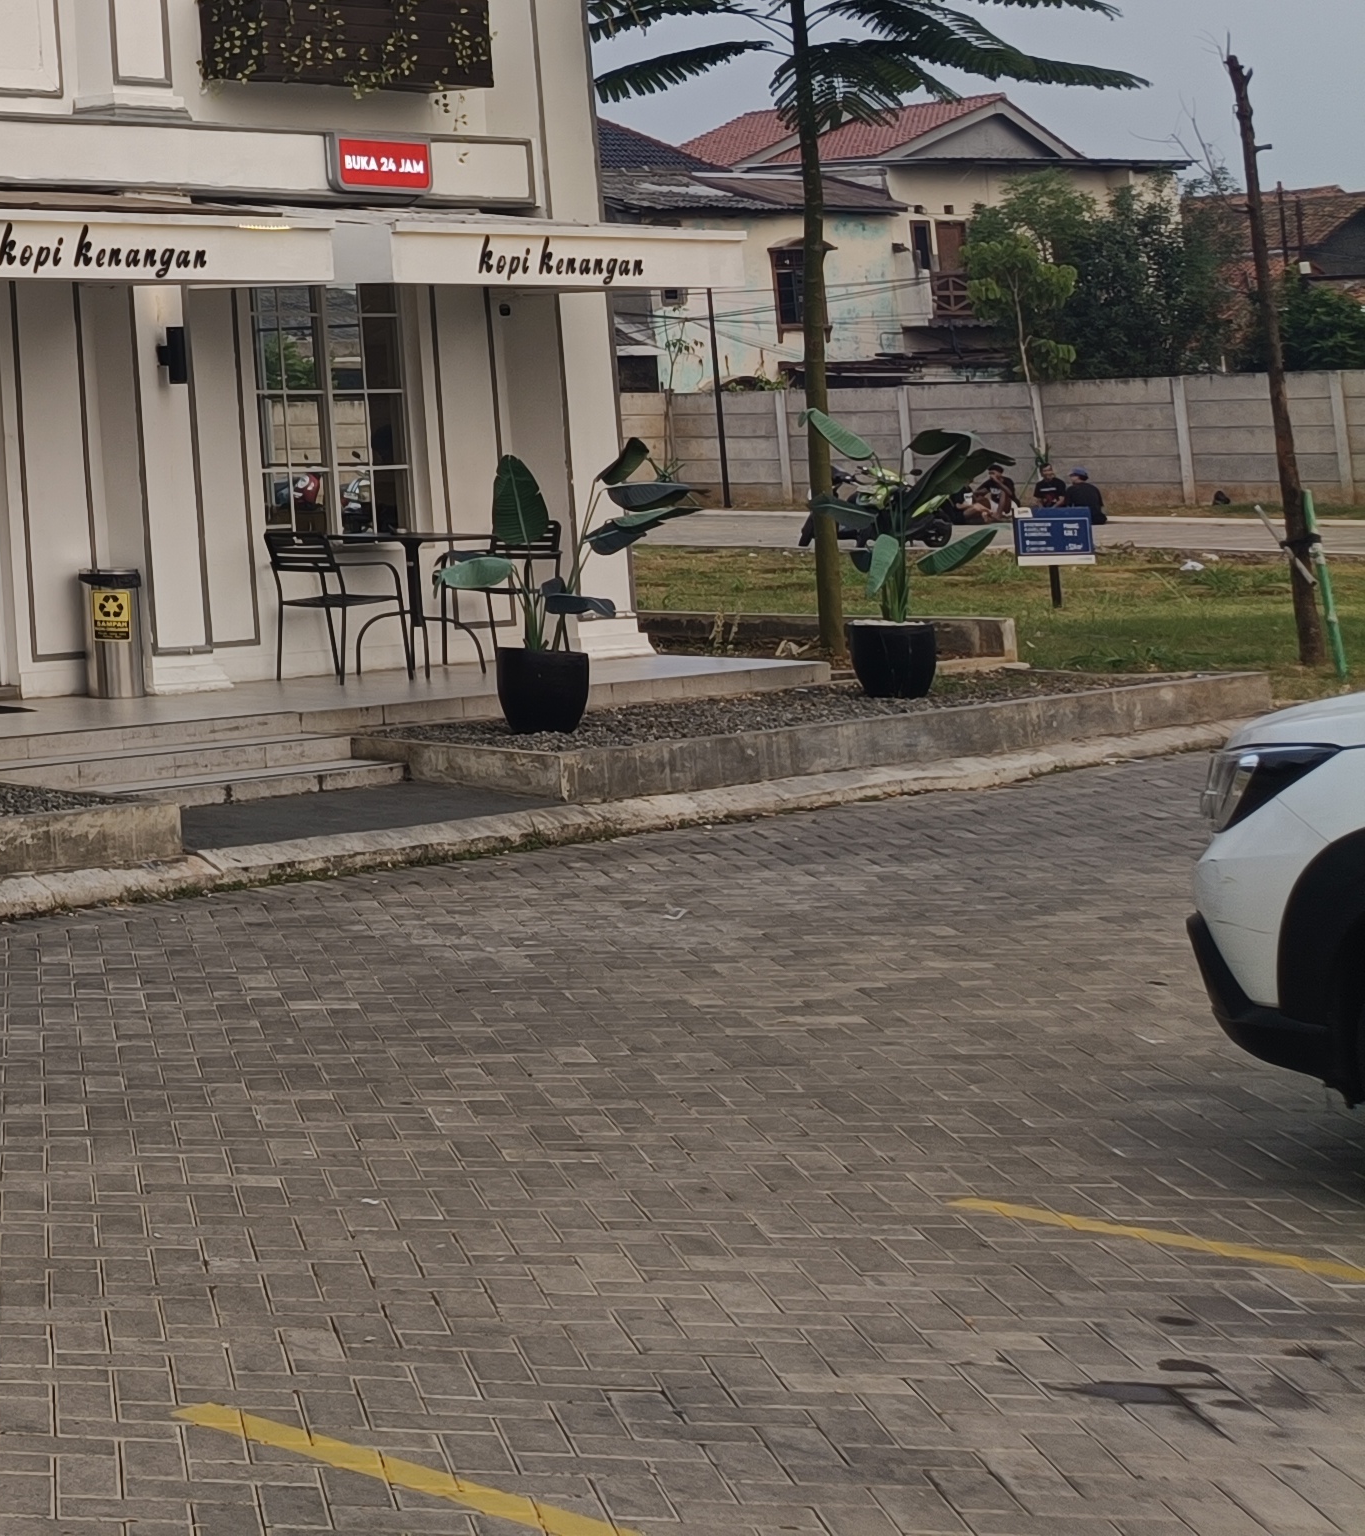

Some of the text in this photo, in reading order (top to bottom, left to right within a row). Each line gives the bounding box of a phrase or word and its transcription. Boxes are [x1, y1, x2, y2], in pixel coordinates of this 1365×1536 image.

[344, 154, 425, 174] BUKA 24 JAM
[73, 223, 208, 279] kenangan
[478, 233, 645, 286] kopi kenangan
